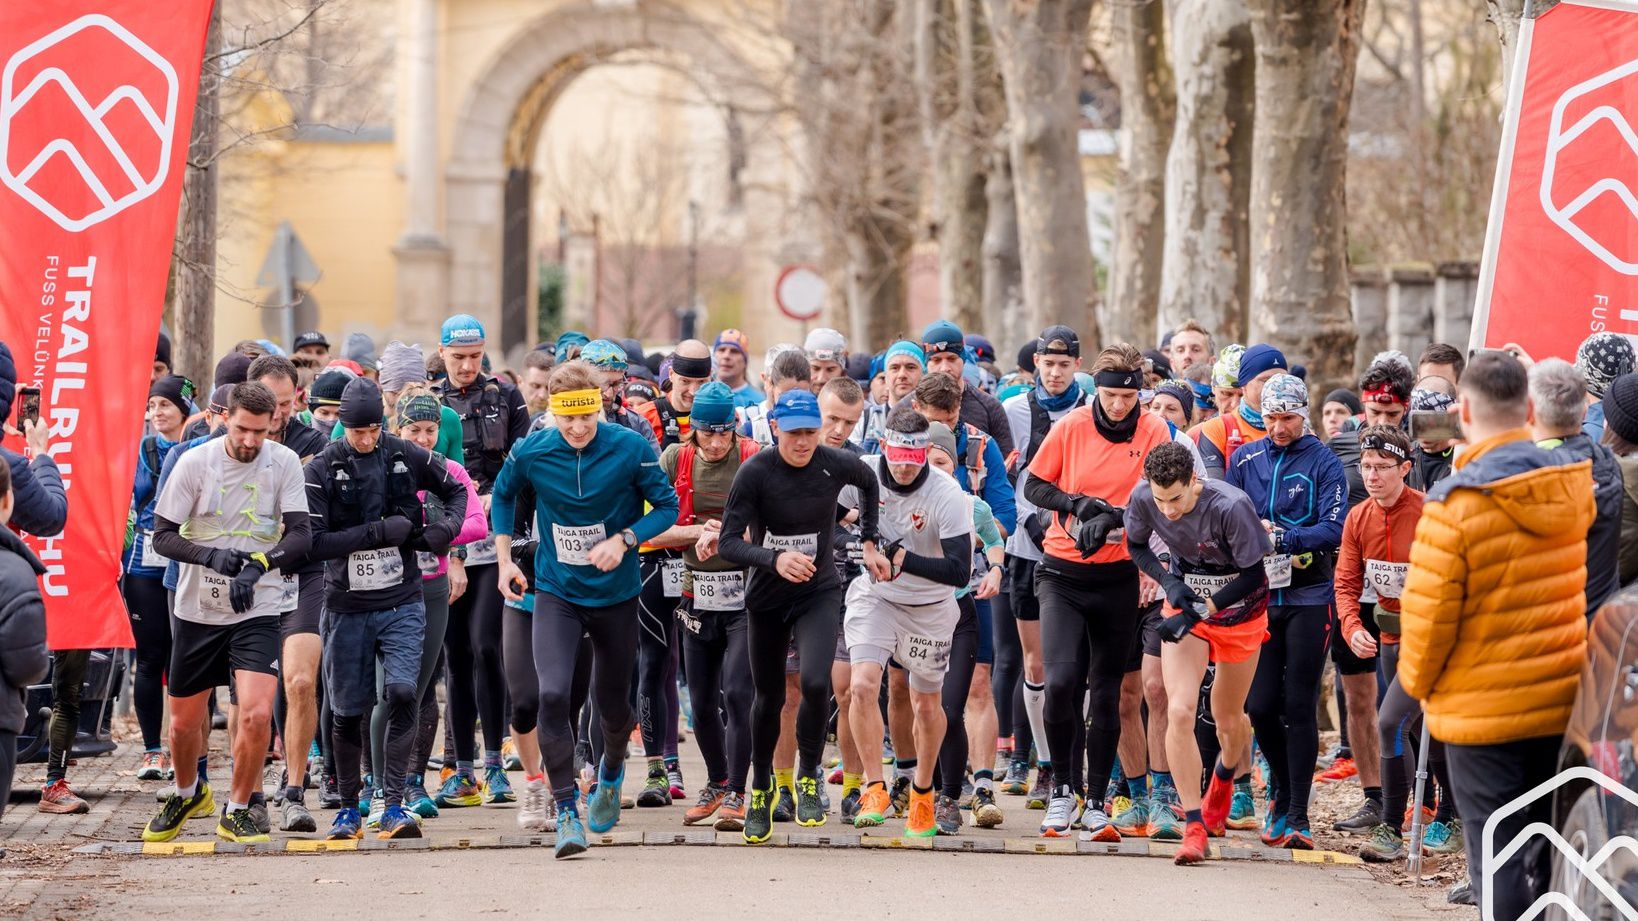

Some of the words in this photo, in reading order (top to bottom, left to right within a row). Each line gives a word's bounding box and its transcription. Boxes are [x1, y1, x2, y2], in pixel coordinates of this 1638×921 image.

[41, 255, 60, 306] FUSS
[1590, 294, 1609, 332] FUS
[561, 398, 595, 408] turista
[1329, 484, 1343, 521] uglow
[578, 527, 601, 537] TRAIL
[559, 537, 582, 551] 103
[792, 538, 813, 546] TRAIL
[377, 550, 397, 560] TRAIL
[356, 563, 375, 577] 85
[666, 562, 684, 570] TAJG
[1374, 573, 1391, 587] 62
[211, 587, 220, 599] 8
[700, 584, 715, 597] 68
[1193, 587, 1212, 599] 29
[909, 646, 928, 660] 84
